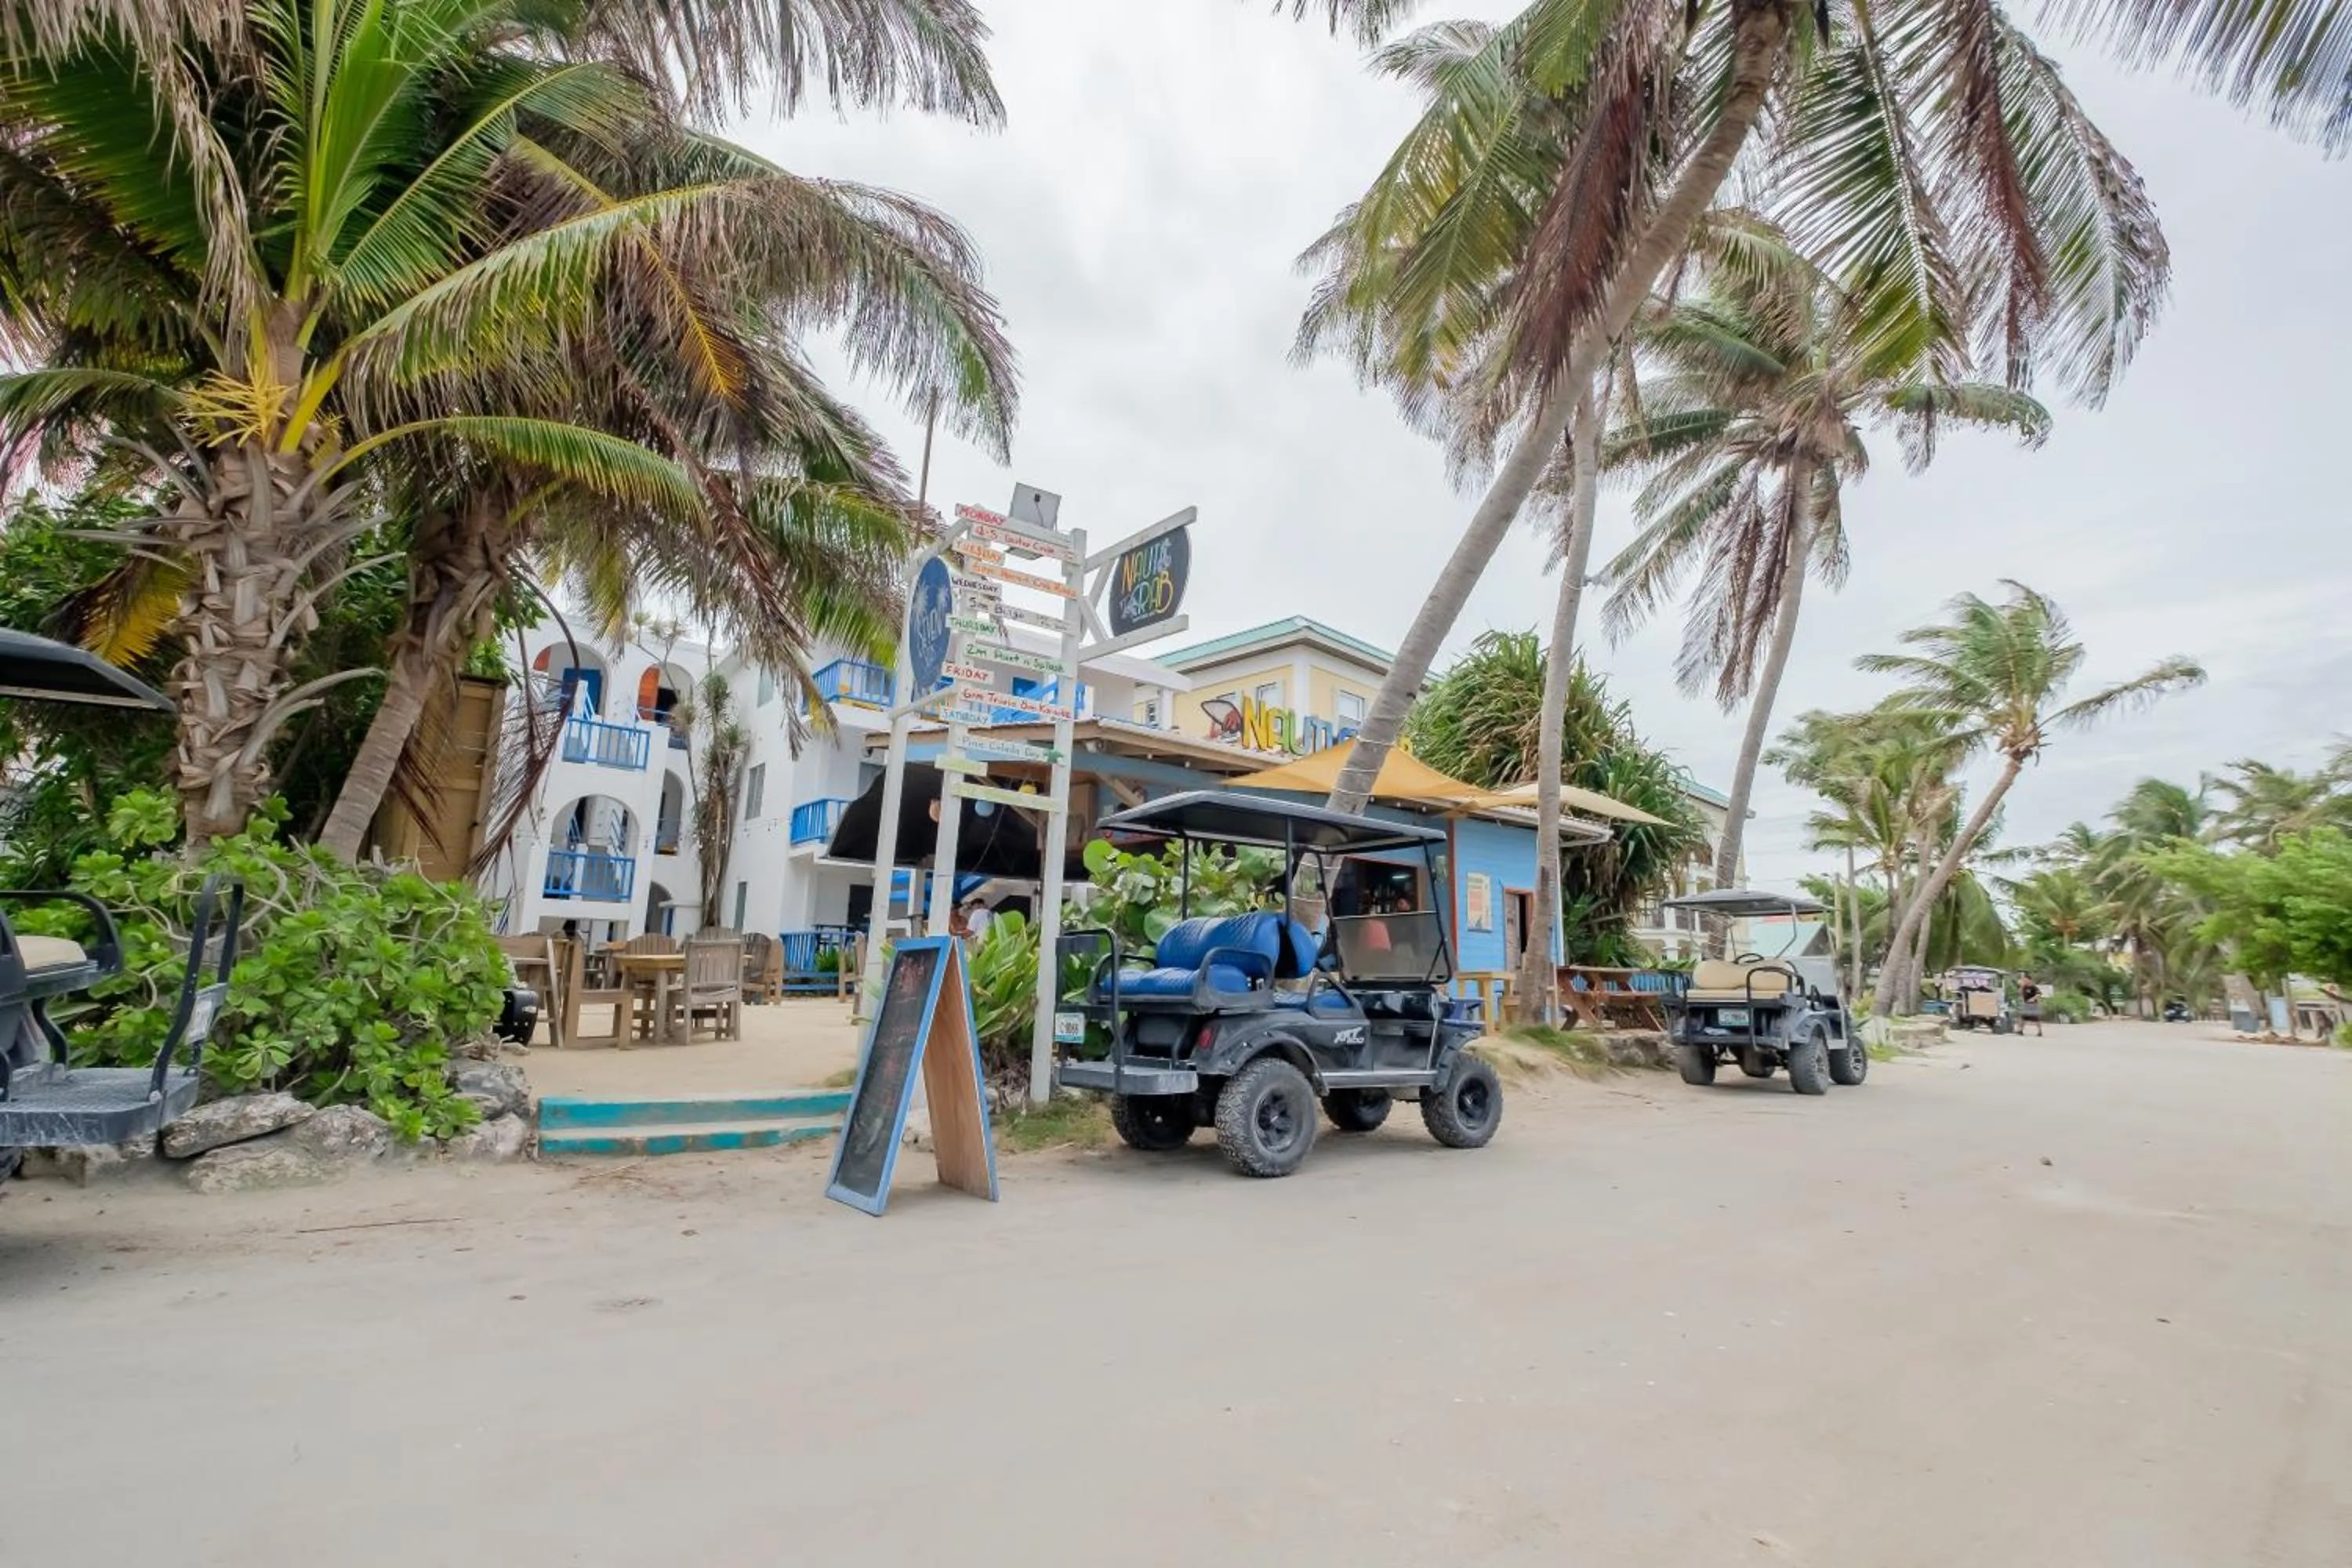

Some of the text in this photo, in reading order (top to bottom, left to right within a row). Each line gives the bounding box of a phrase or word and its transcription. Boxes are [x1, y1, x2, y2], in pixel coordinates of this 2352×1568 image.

[959, 504, 1007, 525] MONDAY
[953, 541, 1003, 563] TUESDAY
[951, 575, 999, 593] WEDNESDAY
[949, 615, 997, 634] THURSDAY
[946, 664, 989, 684] FRIDAY
[943, 709, 989, 724] SATURDAY
